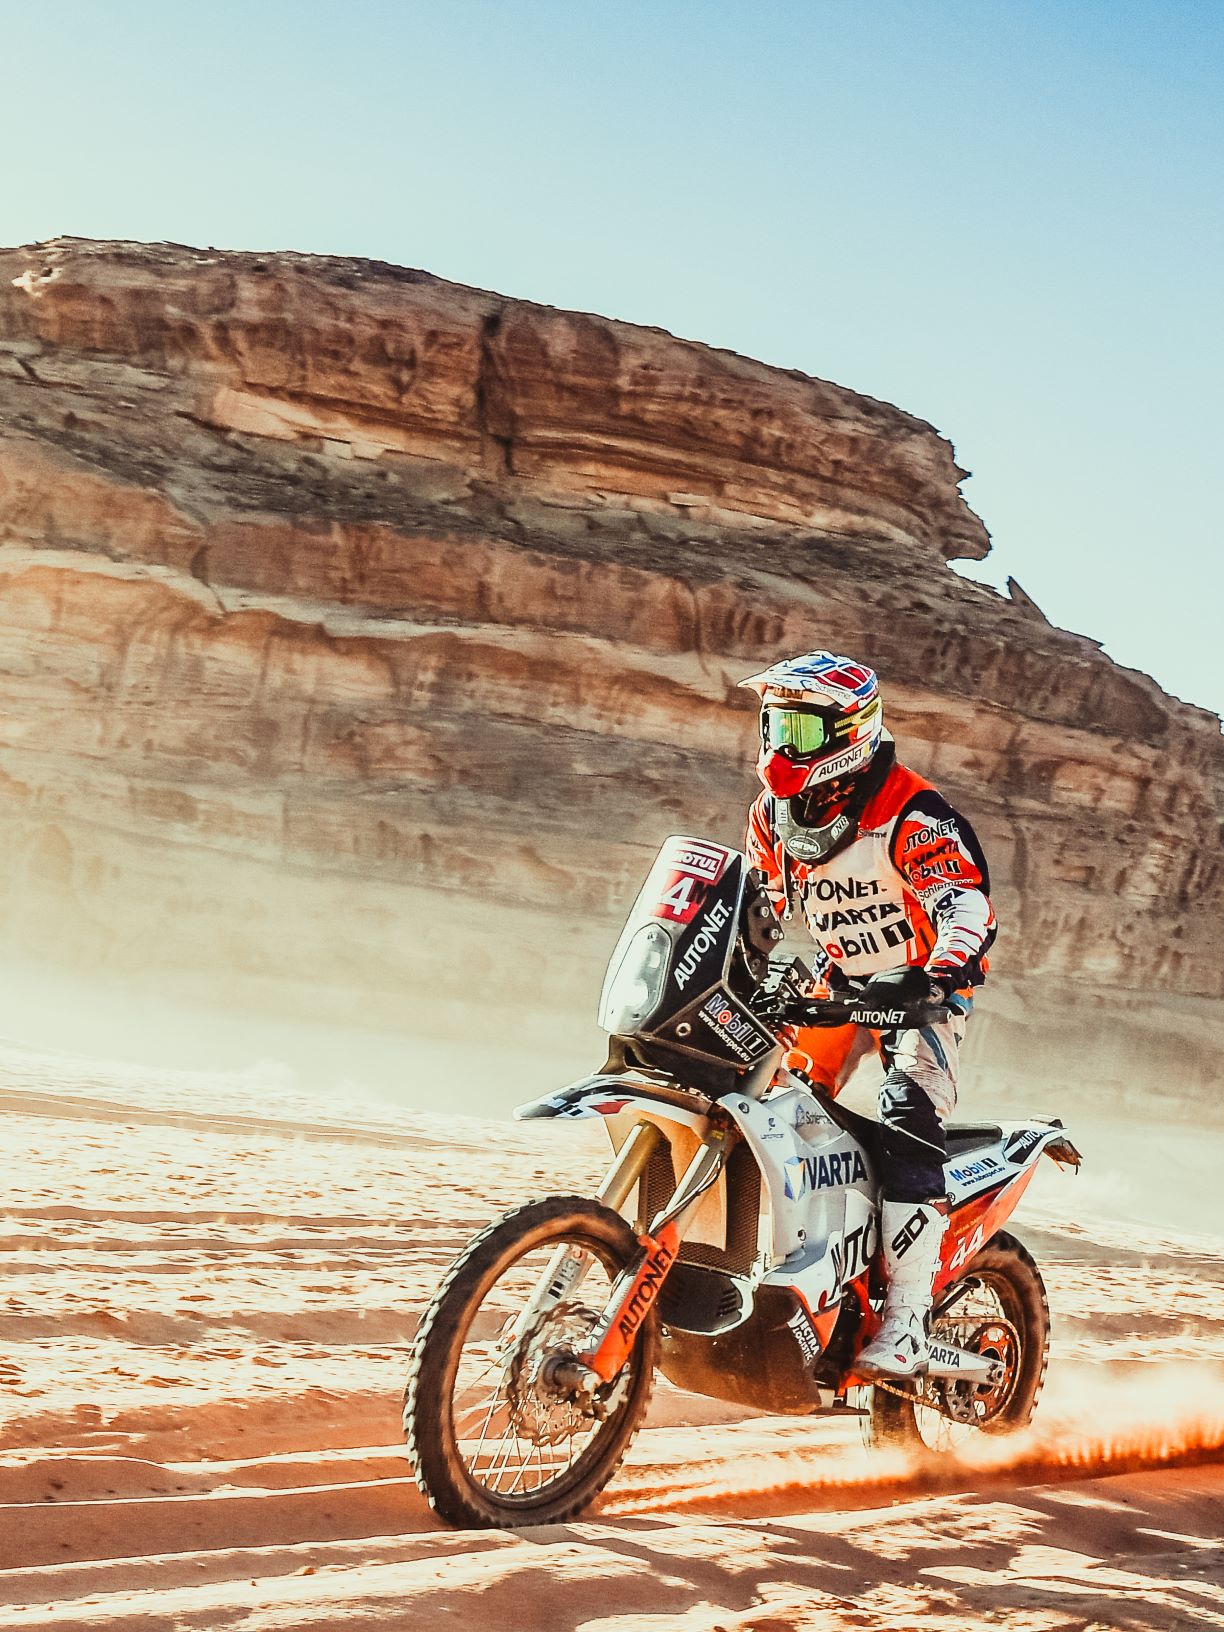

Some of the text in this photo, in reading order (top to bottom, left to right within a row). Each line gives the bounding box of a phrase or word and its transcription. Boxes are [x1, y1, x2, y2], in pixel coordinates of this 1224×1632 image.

[819, 747, 864, 777] AUTONET
[824, 931, 880, 959] obil
[704, 993, 754, 1041] Mobil
[849, 1008, 906, 1026] AUTONET
[805, 1151, 868, 1191] VARTA
[949, 1161, 987, 1182] Mobil
